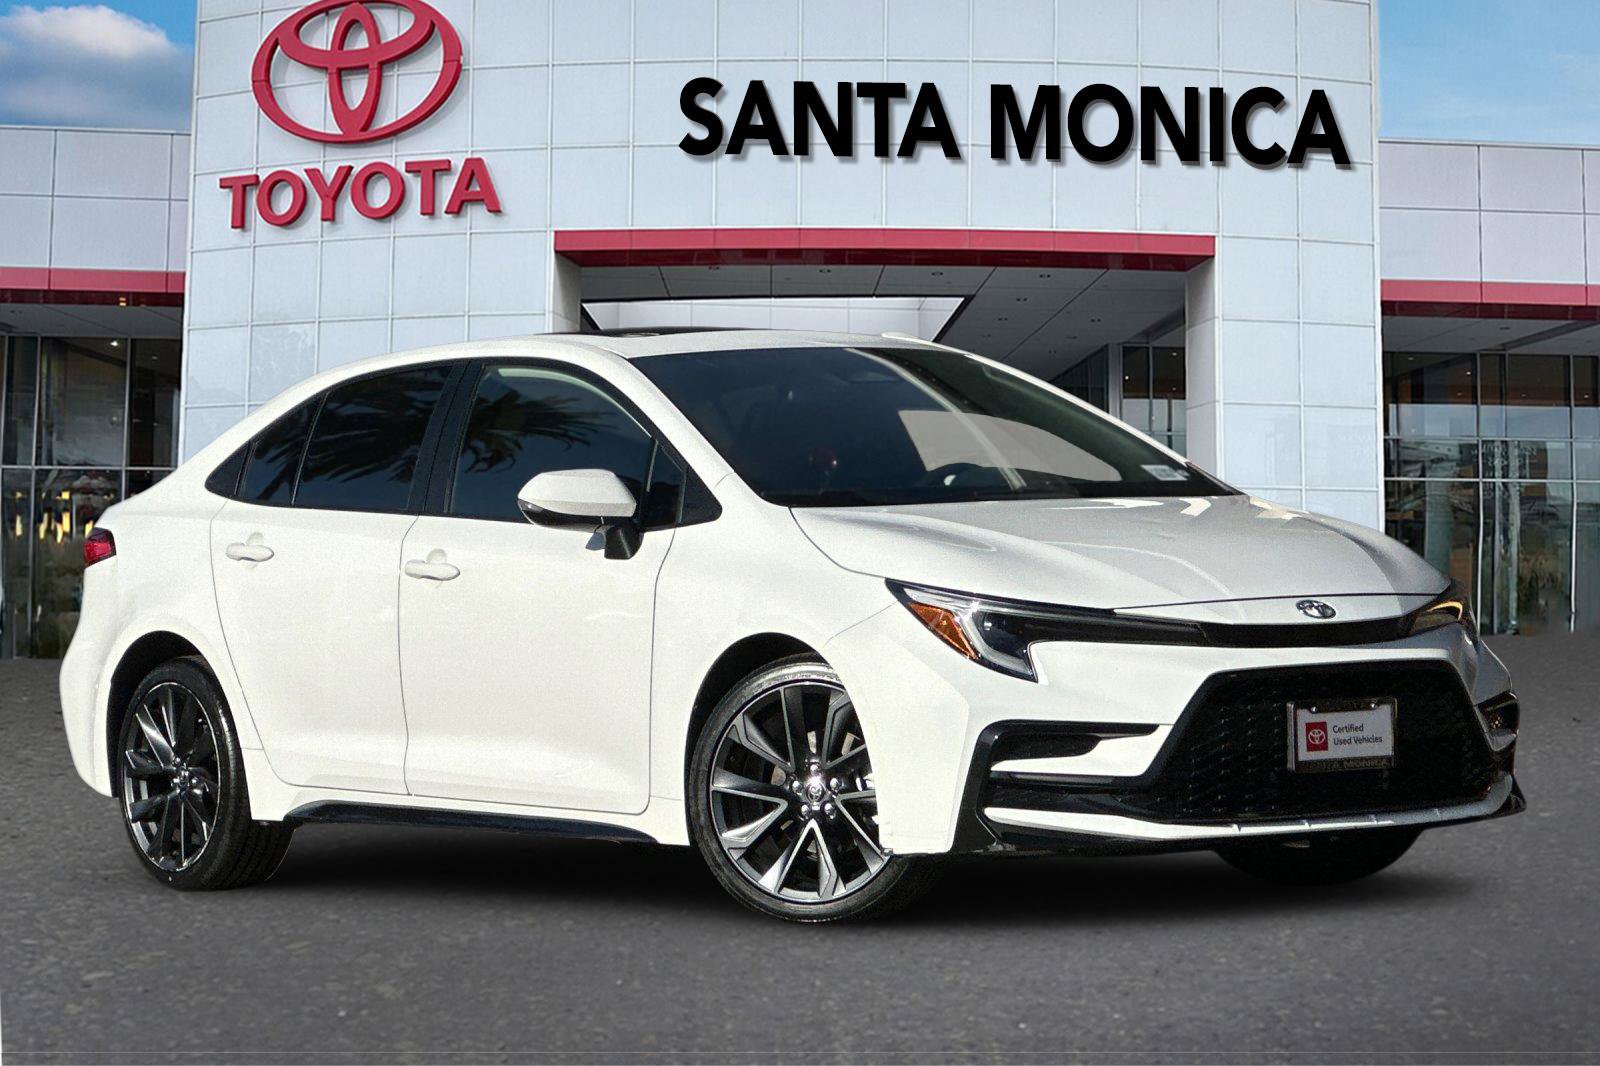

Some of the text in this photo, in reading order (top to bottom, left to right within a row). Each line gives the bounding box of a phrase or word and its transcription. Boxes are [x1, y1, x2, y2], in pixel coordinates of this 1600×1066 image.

[679, 77, 1351, 168] SANTA MONICA
[219, 157, 502, 229] TOYOTA
[1332, 723, 1364, 734] Certified
[1333, 734, 1383, 746] Used Vehicles
